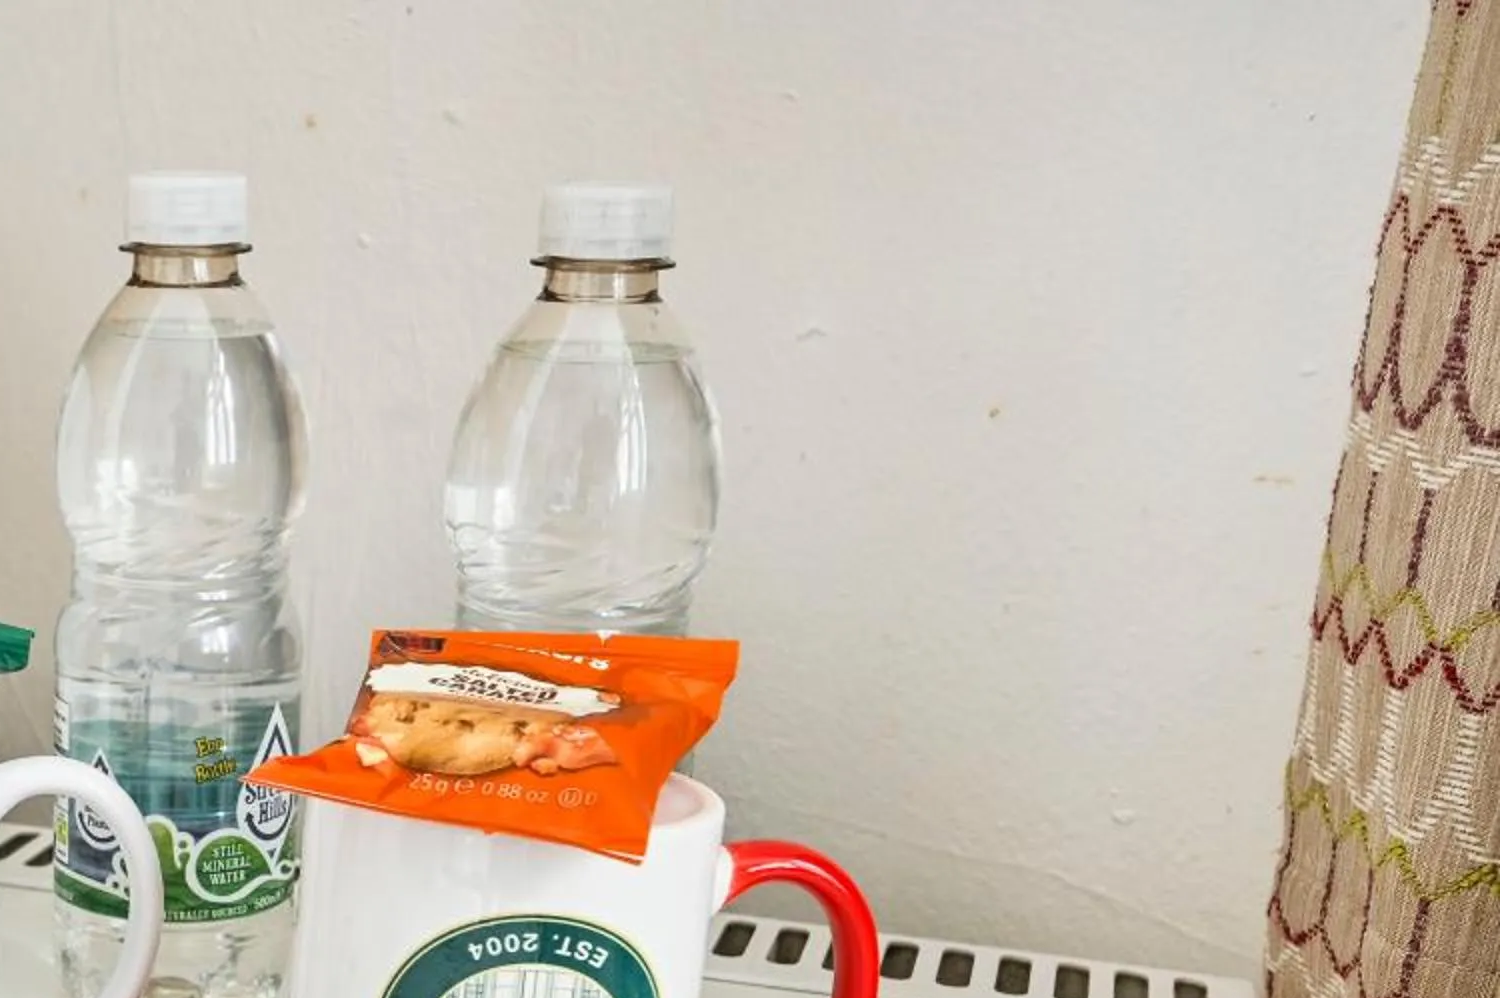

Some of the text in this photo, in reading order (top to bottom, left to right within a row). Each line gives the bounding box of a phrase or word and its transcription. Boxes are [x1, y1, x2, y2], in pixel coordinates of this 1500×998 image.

[211, 843, 245, 859] STILL
[202, 855, 252, 873] MINERAL
[209, 869, 247, 885] WATER
[467, 932, 610, 970] EST. 2004
